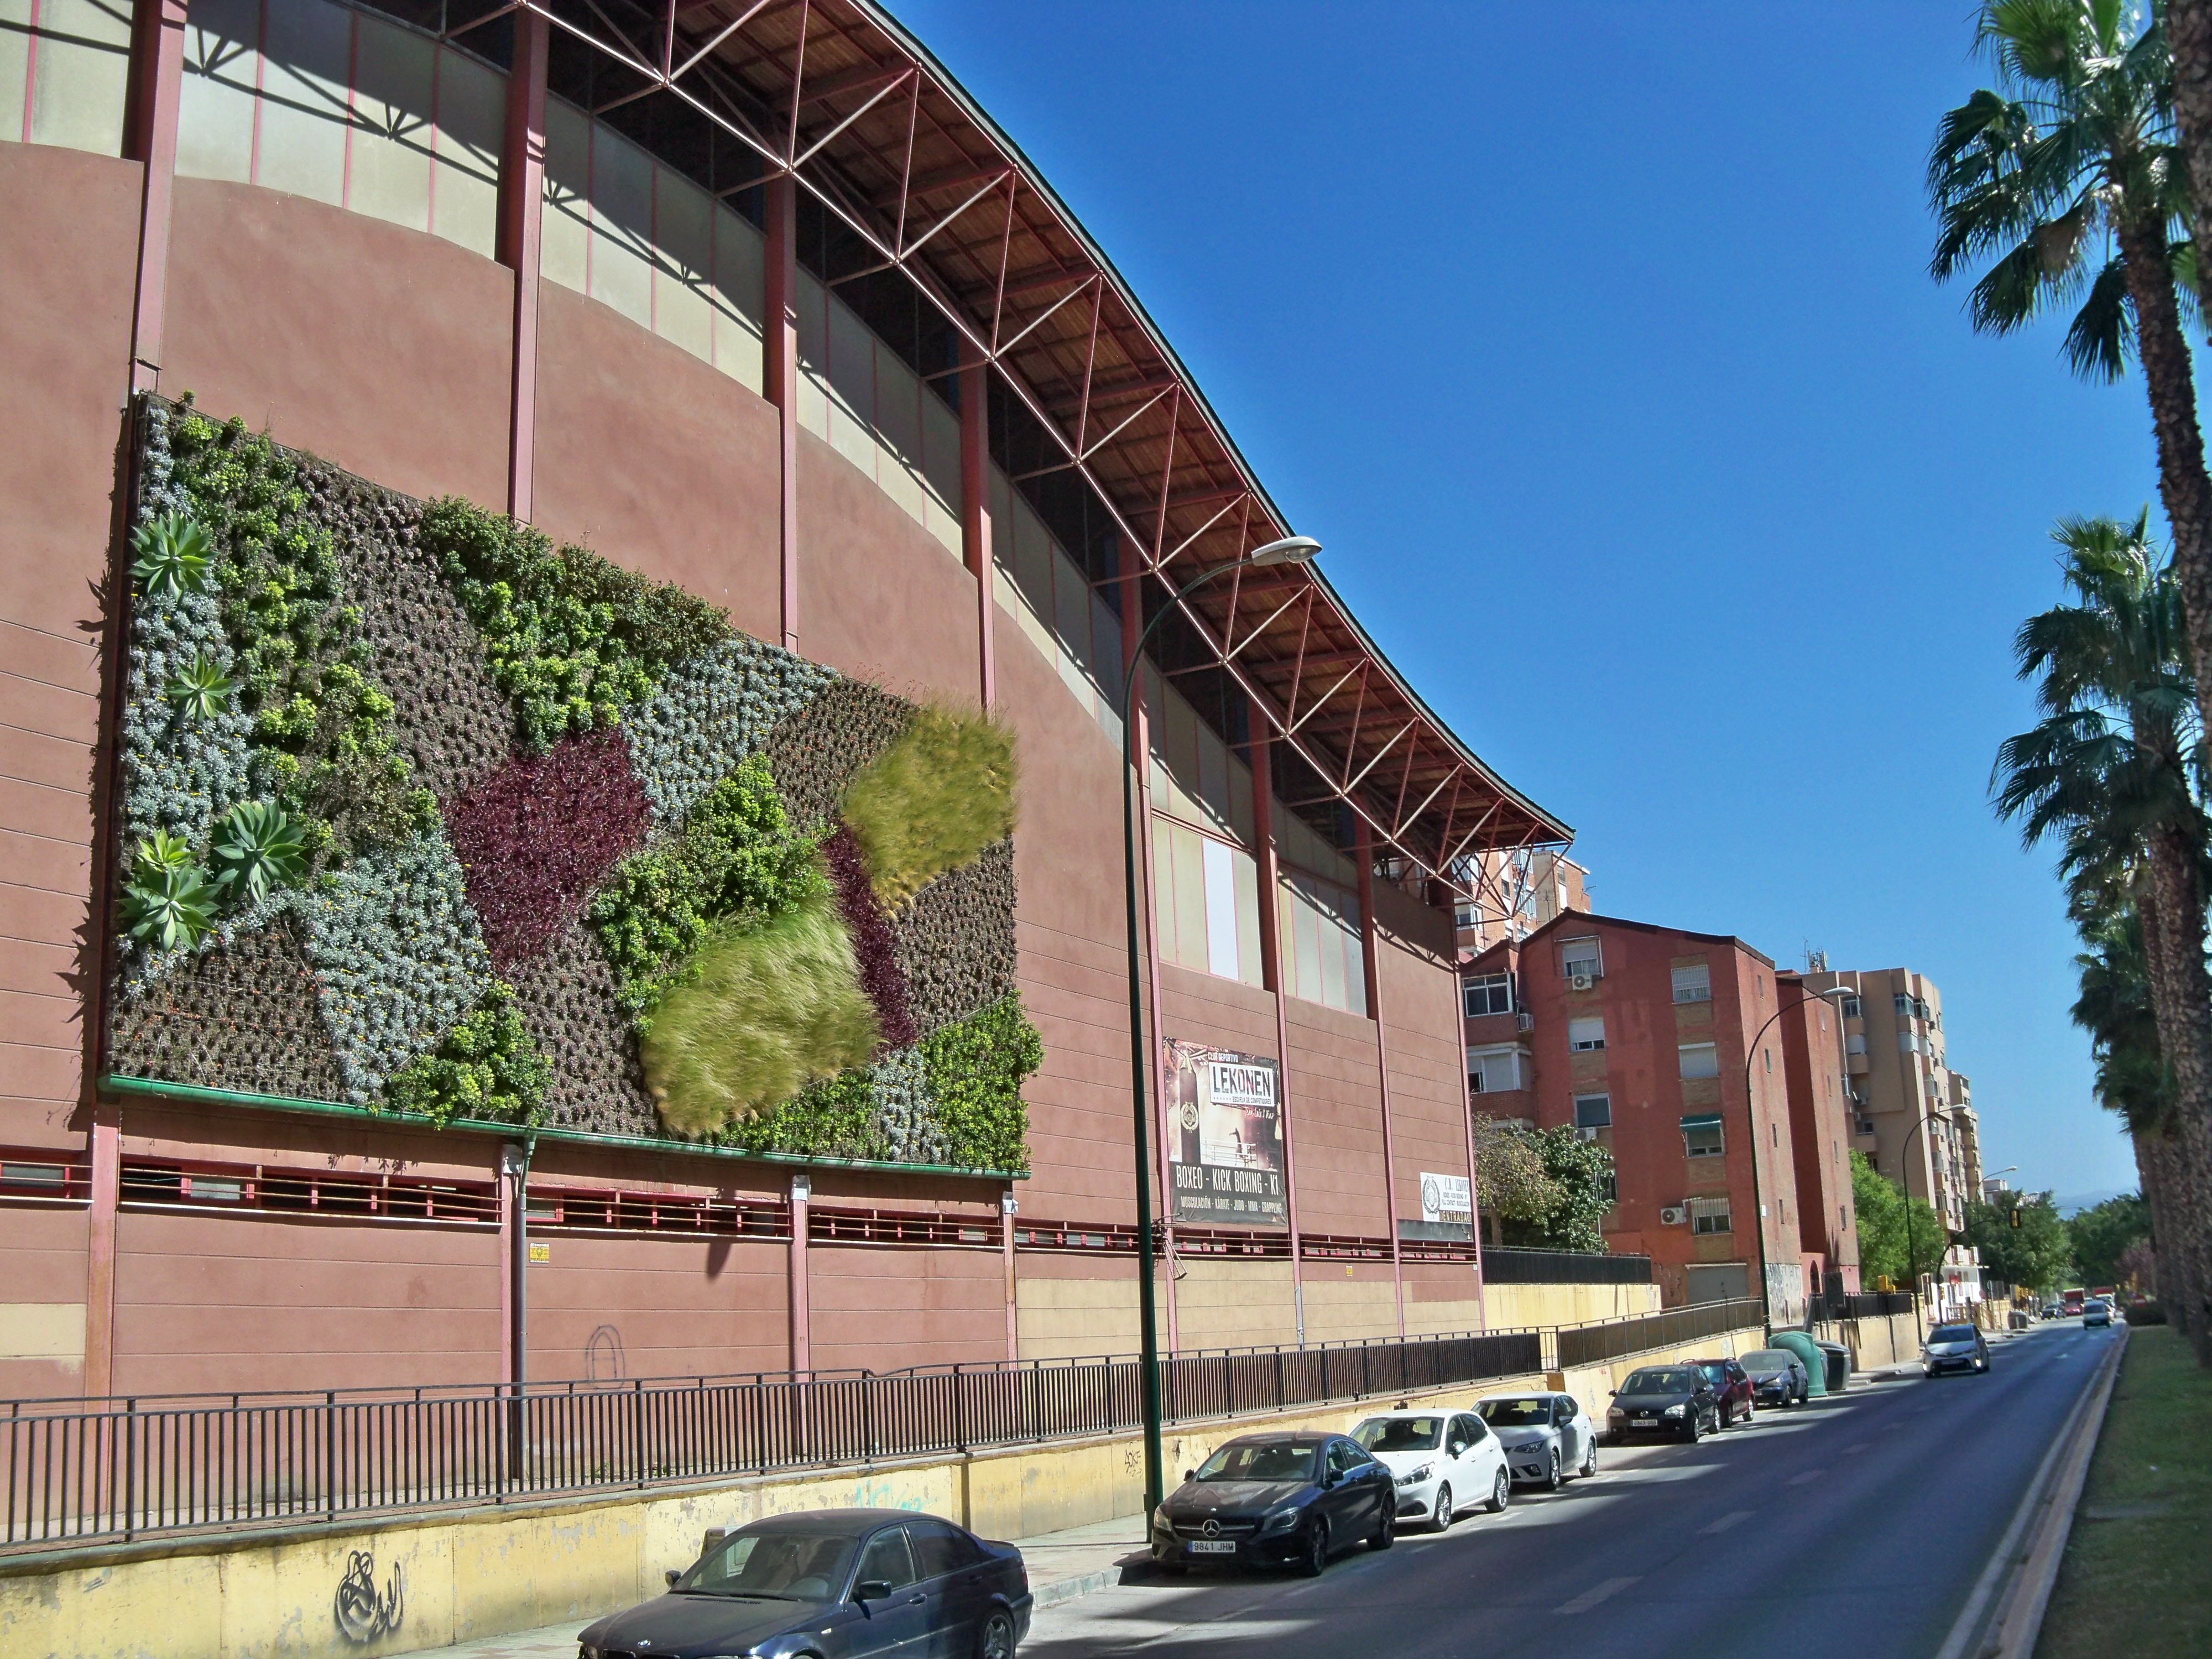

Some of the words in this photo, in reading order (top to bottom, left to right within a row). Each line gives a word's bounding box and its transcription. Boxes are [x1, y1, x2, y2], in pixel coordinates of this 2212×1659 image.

[1208, 1051, 1218, 1061] CLUB
[1218, 1052, 1238, 1062] DEPORTIVO
[1212, 1066, 1271, 1097] LEKONEN
[1176, 1165, 1203, 1190] BOXEO
[1212, 1168, 1232, 1191] KICK
[1234, 1170, 1262, 1193] BOXING
[1270, 1174, 1279, 1196] K1
[1181, 1195, 1211, 1209] MUSCULACIÓN
[1214, 1196, 1230, 1210] KÁRATE
[1234, 1199, 1244, 1211] JUDO
[1248, 1200, 1258, 1212] MMA
[1261, 1201, 1282, 1213] GRAPPLING
[1194, 1542, 1213, 1551] 9841
[1218, 1542, 1234, 1551] JHM
